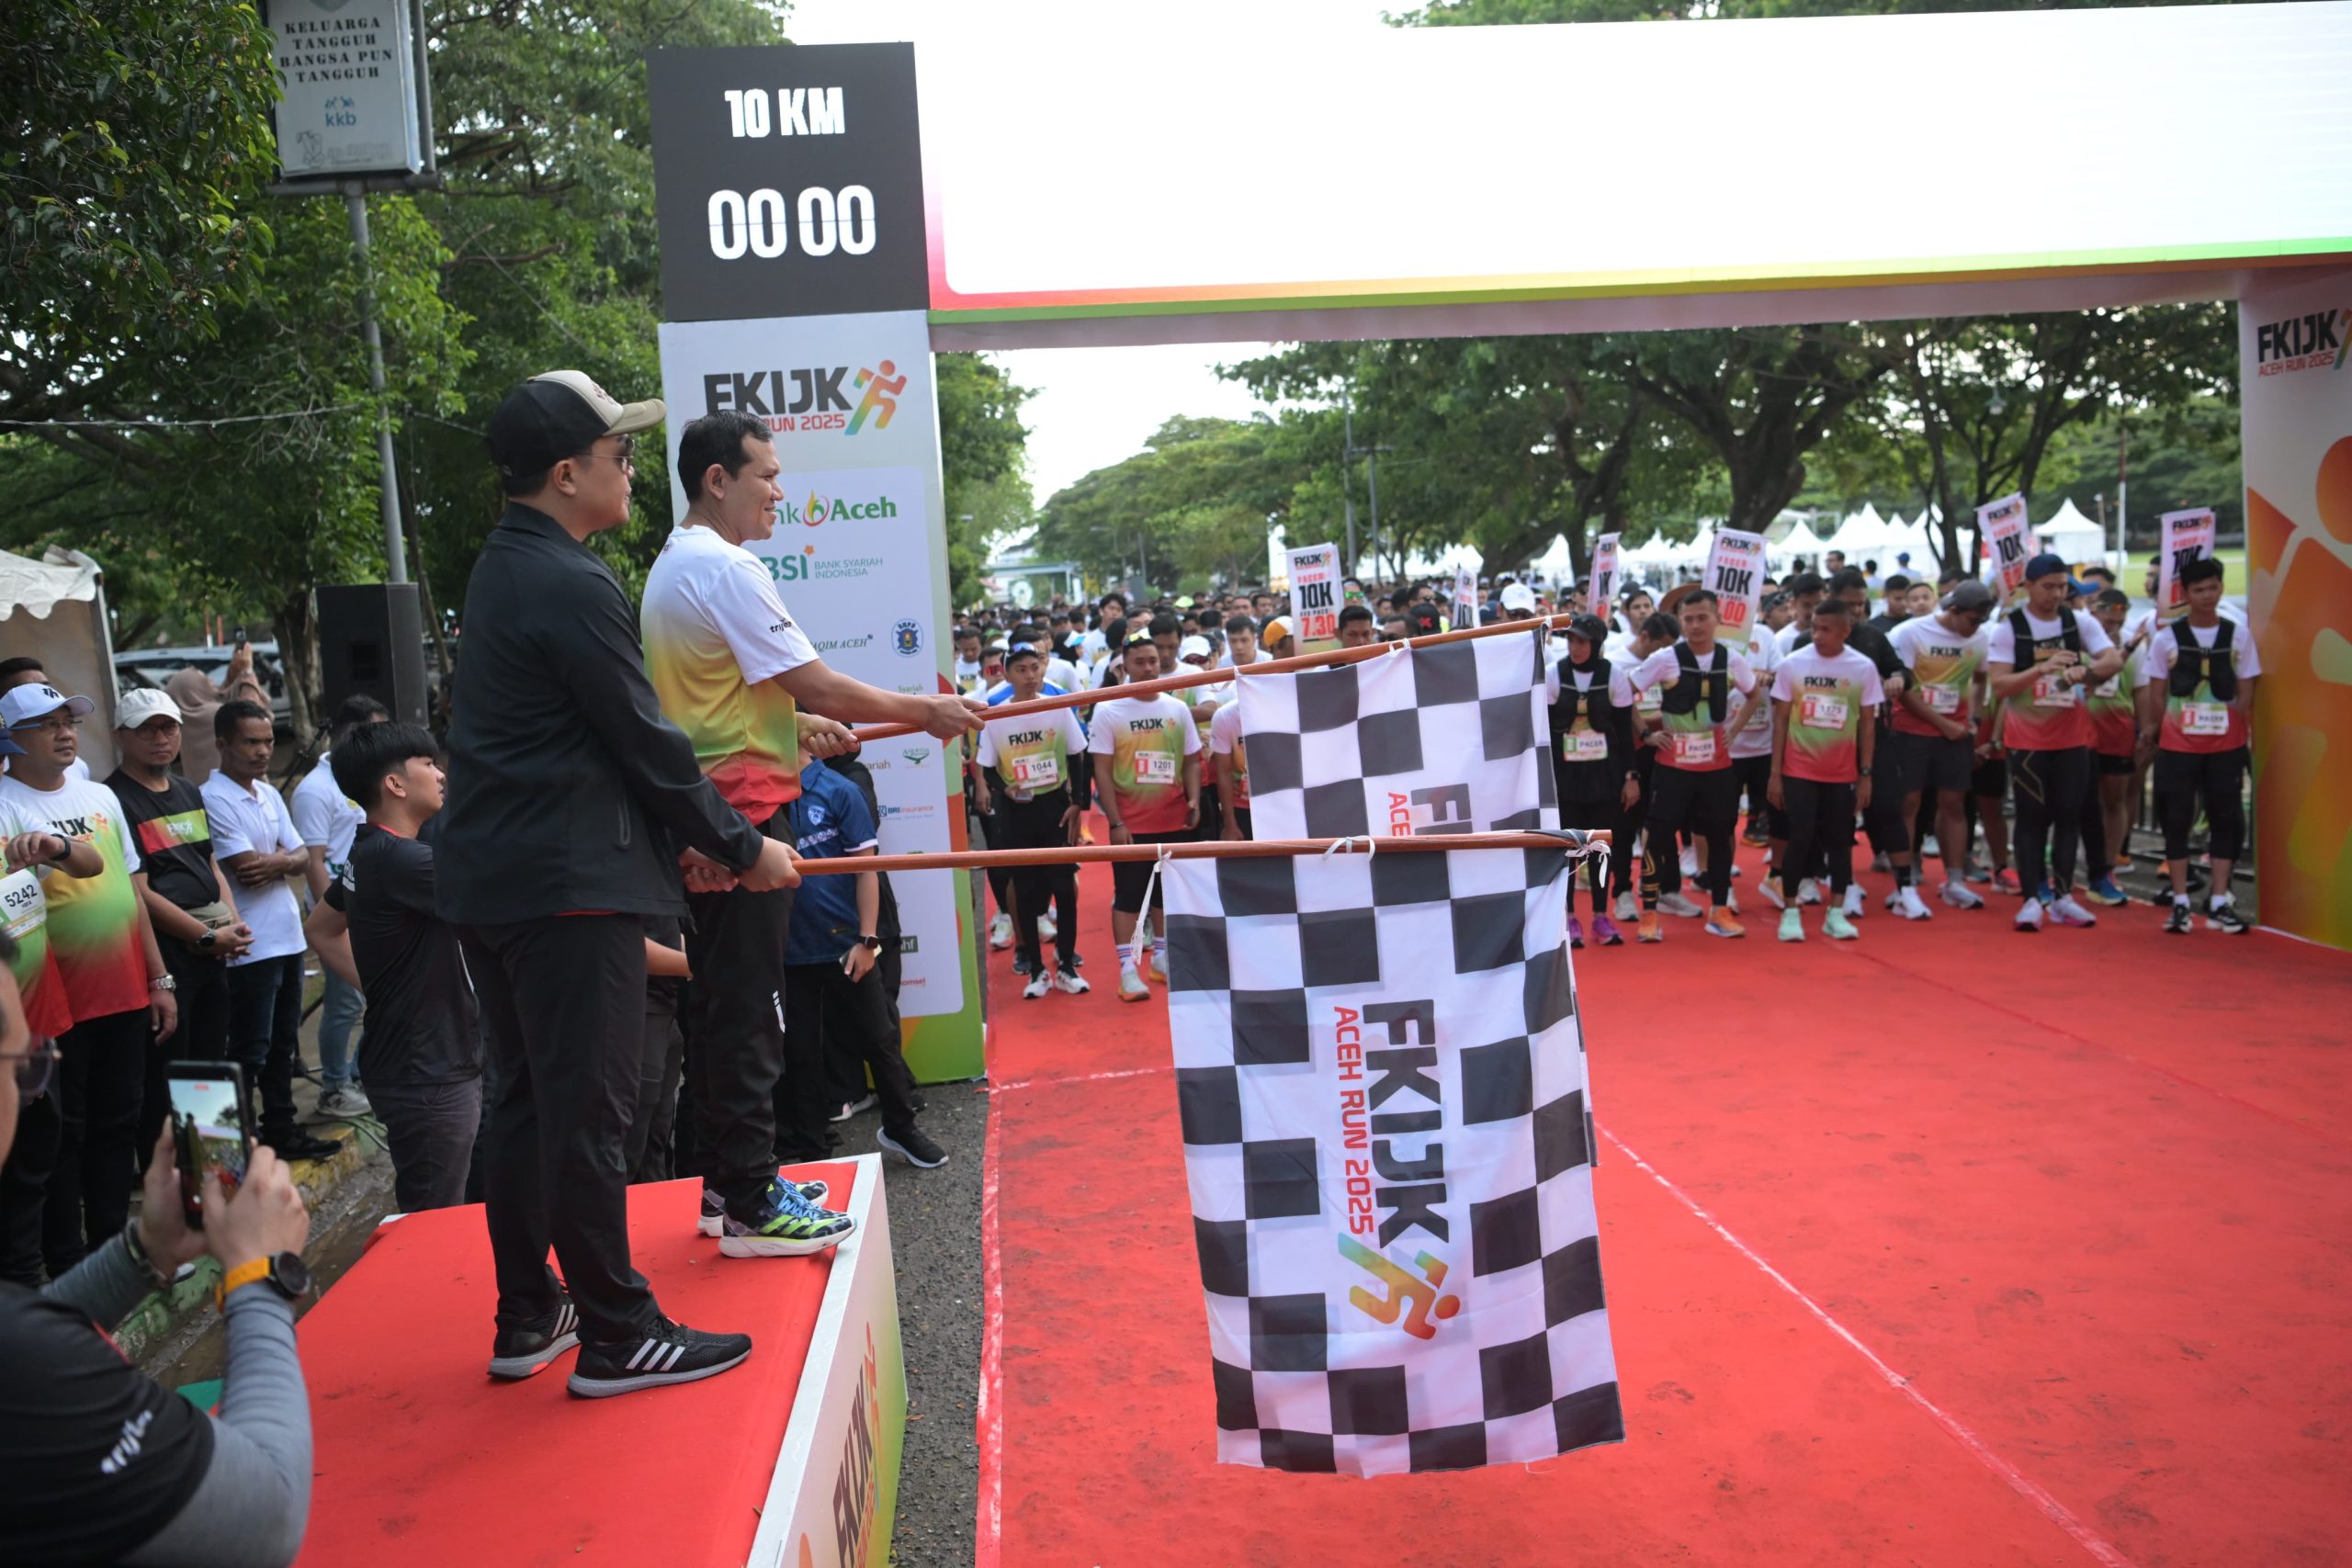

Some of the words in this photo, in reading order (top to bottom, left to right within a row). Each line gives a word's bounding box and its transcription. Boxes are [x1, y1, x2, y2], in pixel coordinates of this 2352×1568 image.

[284, 17, 381, 34] KELUARGA
[292, 34, 377, 50] TANGGUH
[279, 51, 350, 68] BANGSA
[357, 49, 393, 62] PUN
[295, 66, 380, 83] TANGGUH
[325, 112, 356, 127] kkb
[724, 88, 771, 138] 10
[778, 86, 845, 136] KM
[707, 187, 787, 260] 00
[797, 184, 876, 256] 00
[2256, 308, 2339, 363] FKIJK
[2259, 362, 2284, 378] ACEH
[2285, 358, 2306, 372] RUN
[2308, 352, 2335, 368] 2025
[704, 367, 853, 416] FKIJK
[800, 413, 845, 431] 2025
[775, 502, 801, 525] nk
[830, 496, 898, 522] Aceh
[814, 559, 841, 570] BANK
[842, 558, 883, 568] SYARIAH
[1294, 553, 1323, 567] FKIJK
[815, 569, 868, 579] INDONESIA
[1715, 565, 1753, 596] 10K
[1298, 581, 1334, 609] 10K
[1301, 613, 1337, 637] 7.30
[811, 640, 838, 652] AQIM
[839, 638, 867, 649] ACEH
[1804, 676, 1838, 689] FKIJK
[1130, 718, 1164, 732] FKIJK
[1009, 730, 1044, 746] FKIJK
[1579, 739, 1603, 749] PACER
[866, 760, 890, 771] ariah
[1031, 761, 1052, 772] 1044
[1153, 761, 1171, 770] 1201
[888, 807, 900, 815] BRI
[1388, 792, 1411, 837] ACE
[5, 885, 38, 908] 5242
[1333, 1005, 1363, 1081] ACEH
[1340, 1089, 1368, 1149] RUN
[1363, 998, 1449, 1249] FKIJK
[1344, 1158, 1374, 1235] 2025
